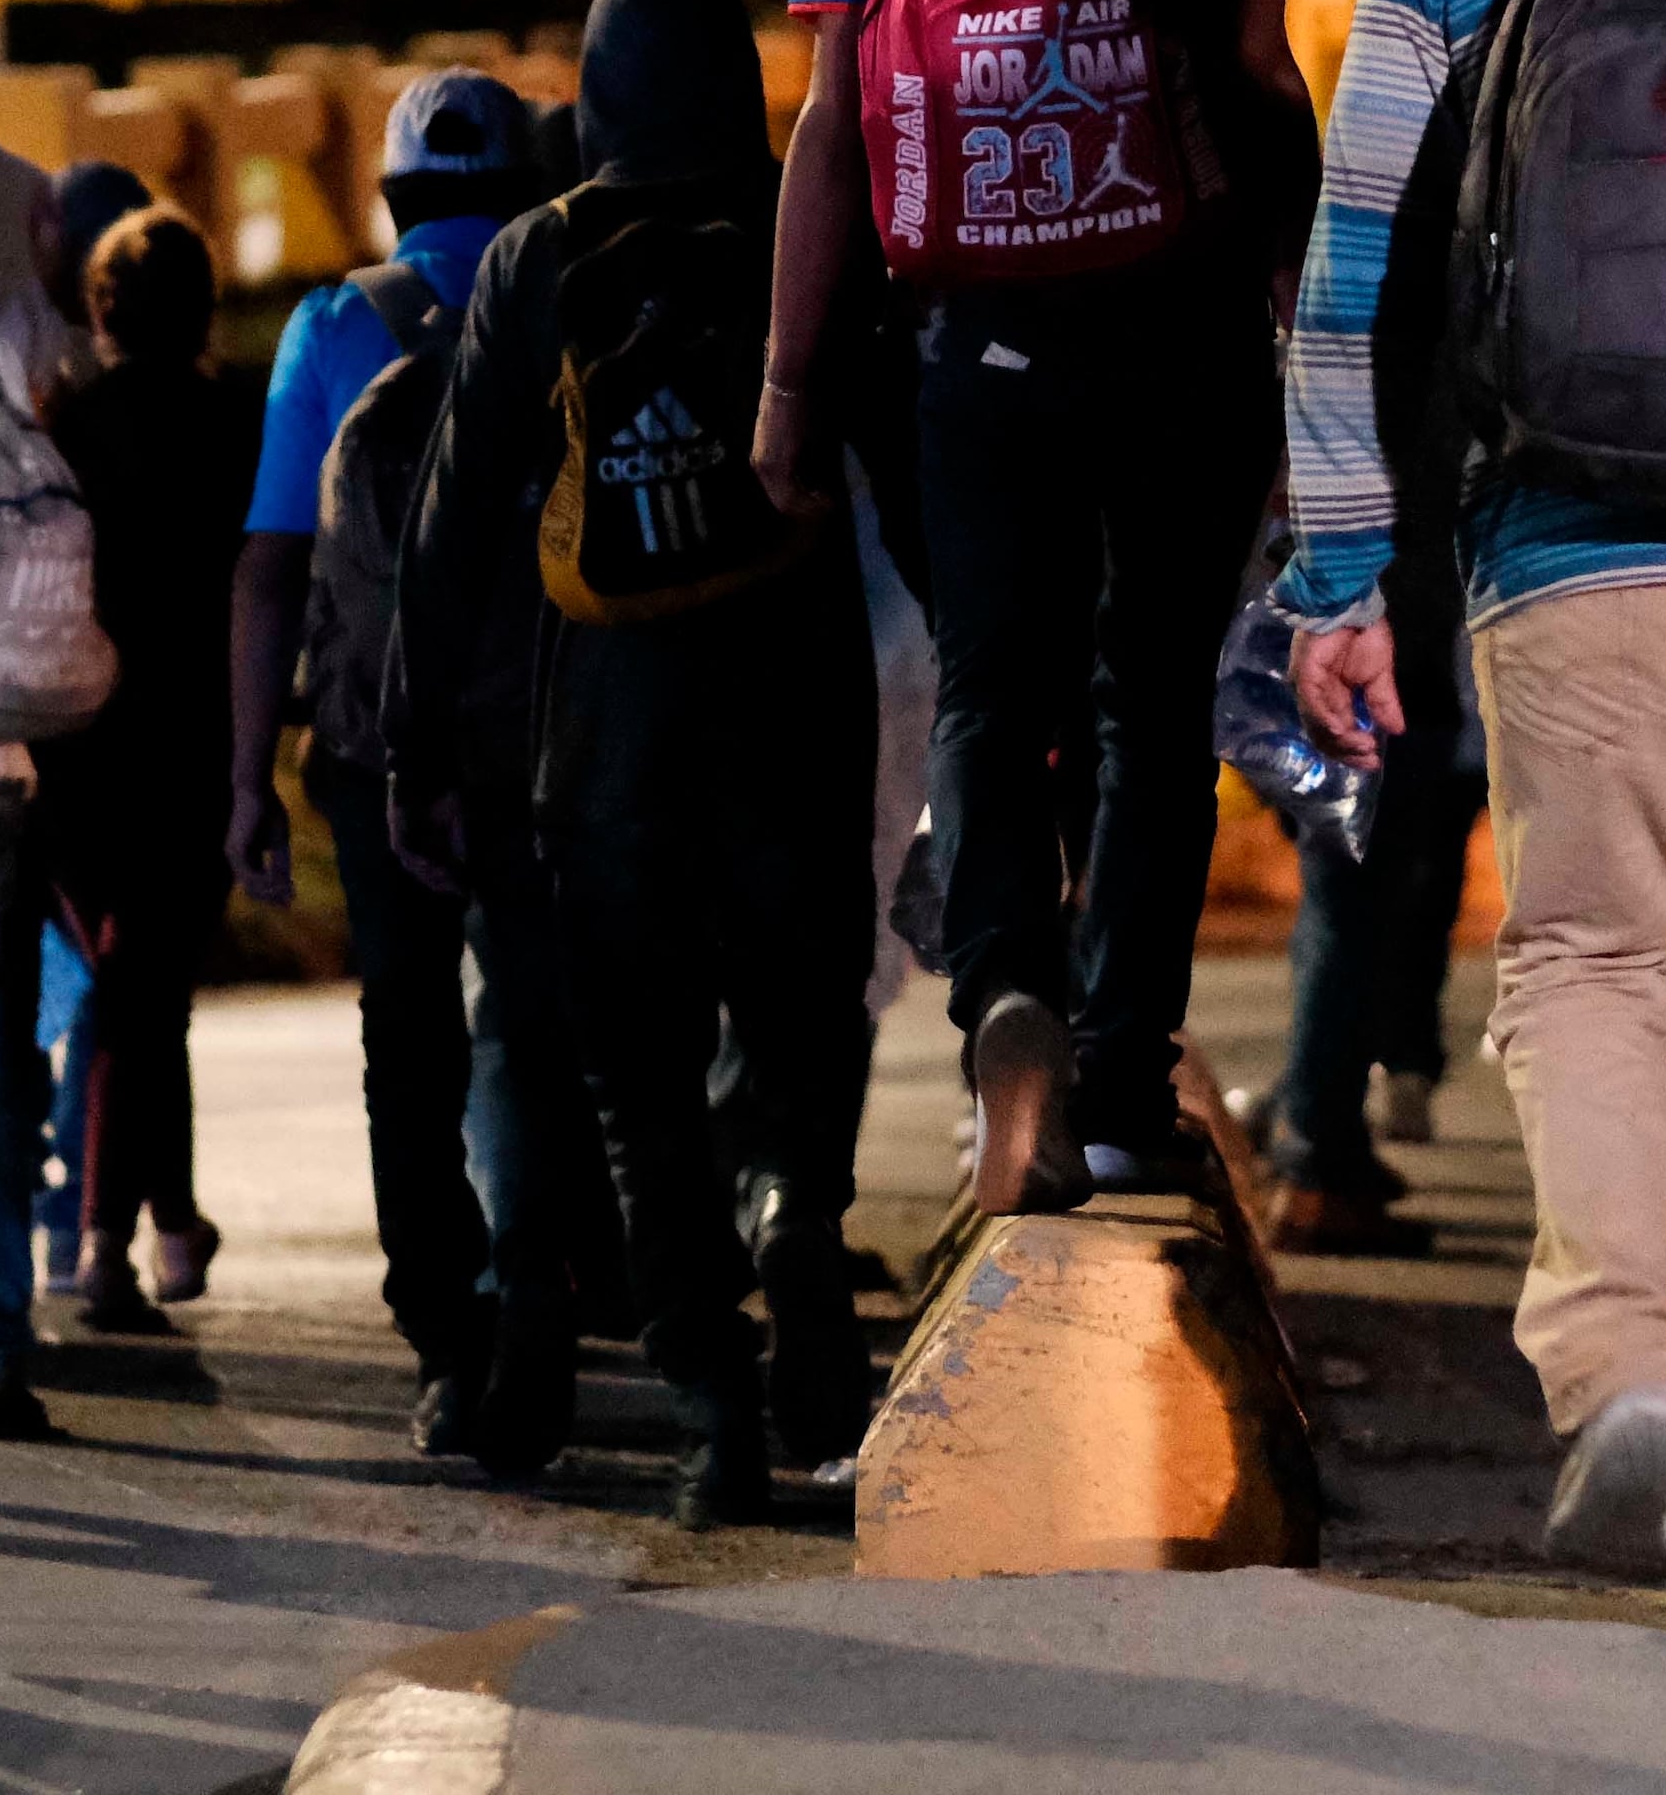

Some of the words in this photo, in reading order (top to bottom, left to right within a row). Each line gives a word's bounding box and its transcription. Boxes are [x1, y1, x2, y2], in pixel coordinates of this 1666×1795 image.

[957, 6, 1043, 35] NIKE
[891, 71, 928, 250] JORDAN
[961, 121, 1074, 219] 23
[956, 203, 1163, 246] CHAMPION
[598, 439, 726, 484] adidas
